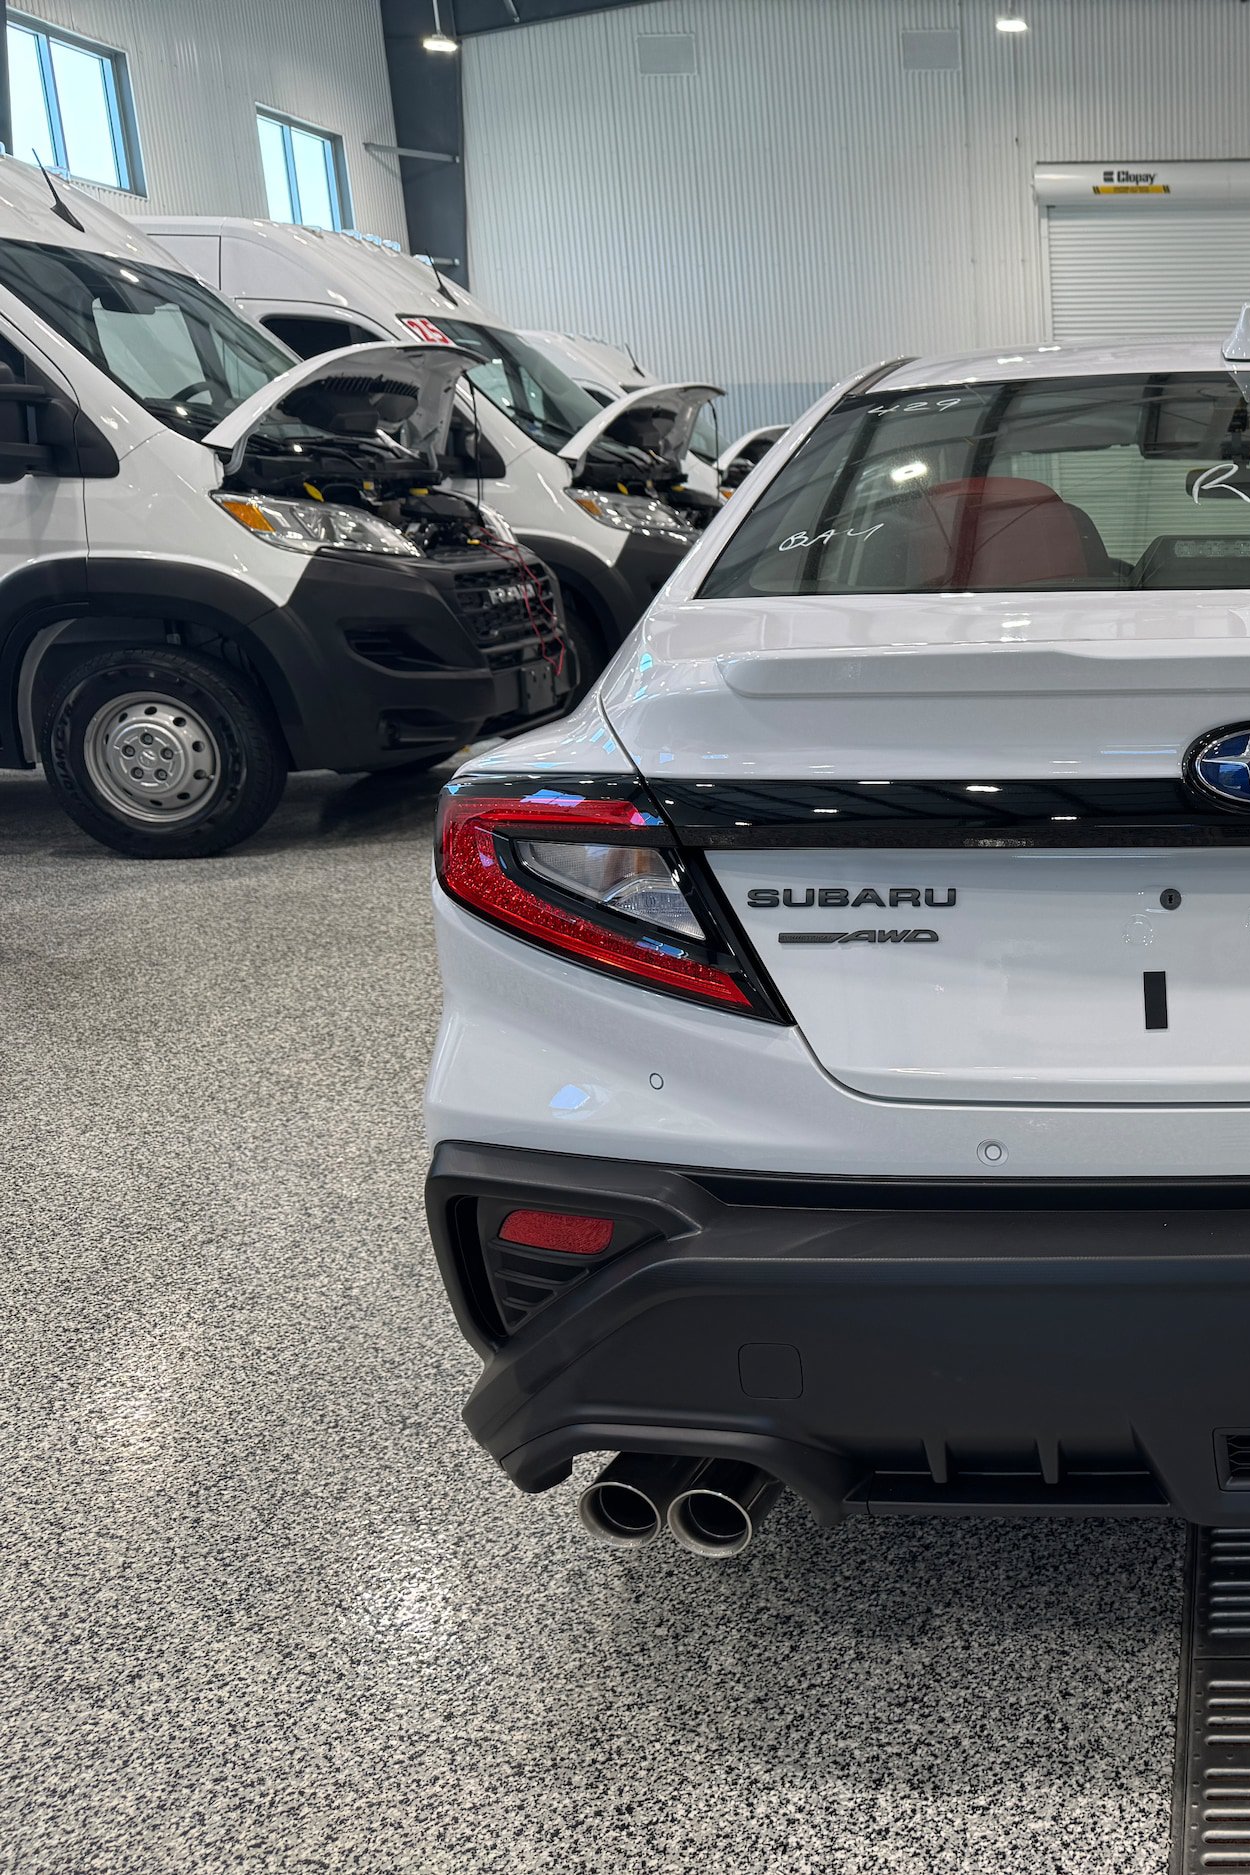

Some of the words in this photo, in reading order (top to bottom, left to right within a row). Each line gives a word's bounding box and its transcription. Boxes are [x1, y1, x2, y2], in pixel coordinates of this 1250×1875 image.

[1117, 170, 1156, 185] Clopay
[867, 398, 961, 416] 429
[779, 523, 884, 551] BAY
[747, 888, 957, 908] SUBARU
[838, 929, 939, 943] AWD
